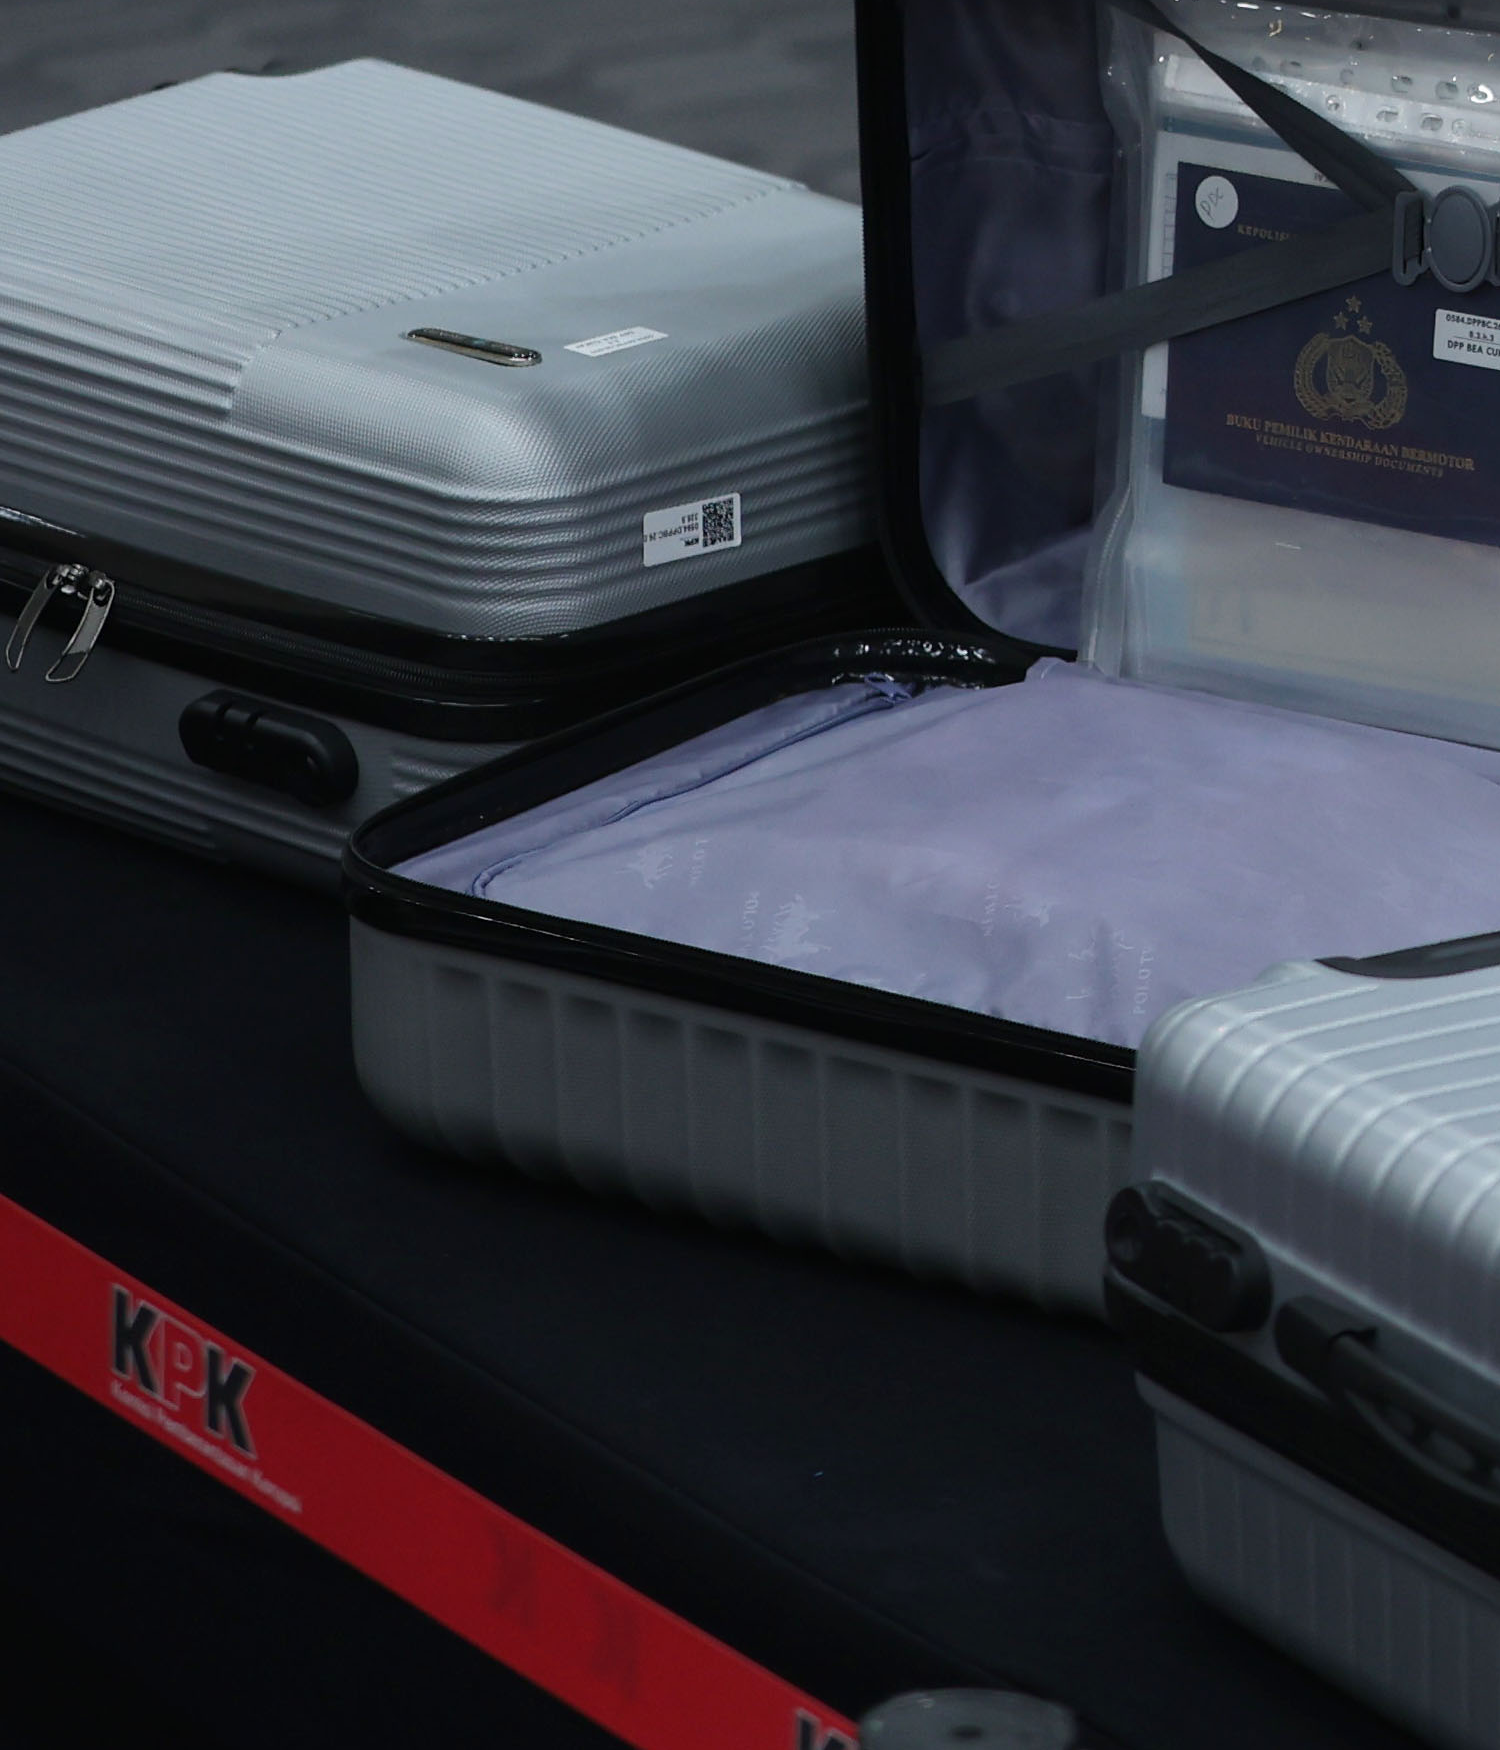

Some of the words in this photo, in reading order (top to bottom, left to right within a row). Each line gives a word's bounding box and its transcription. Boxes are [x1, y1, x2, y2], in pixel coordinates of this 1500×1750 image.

[1447, 339, 1465, 351] DPP
[1466, 343, 1484, 355] BEA
[1226, 413, 1262, 431] BUKU
[1263, 420, 1318, 443] PEMILIK
[1319, 432, 1399, 456] KENDARAAN
[112, 1281, 258, 1462] KPK
